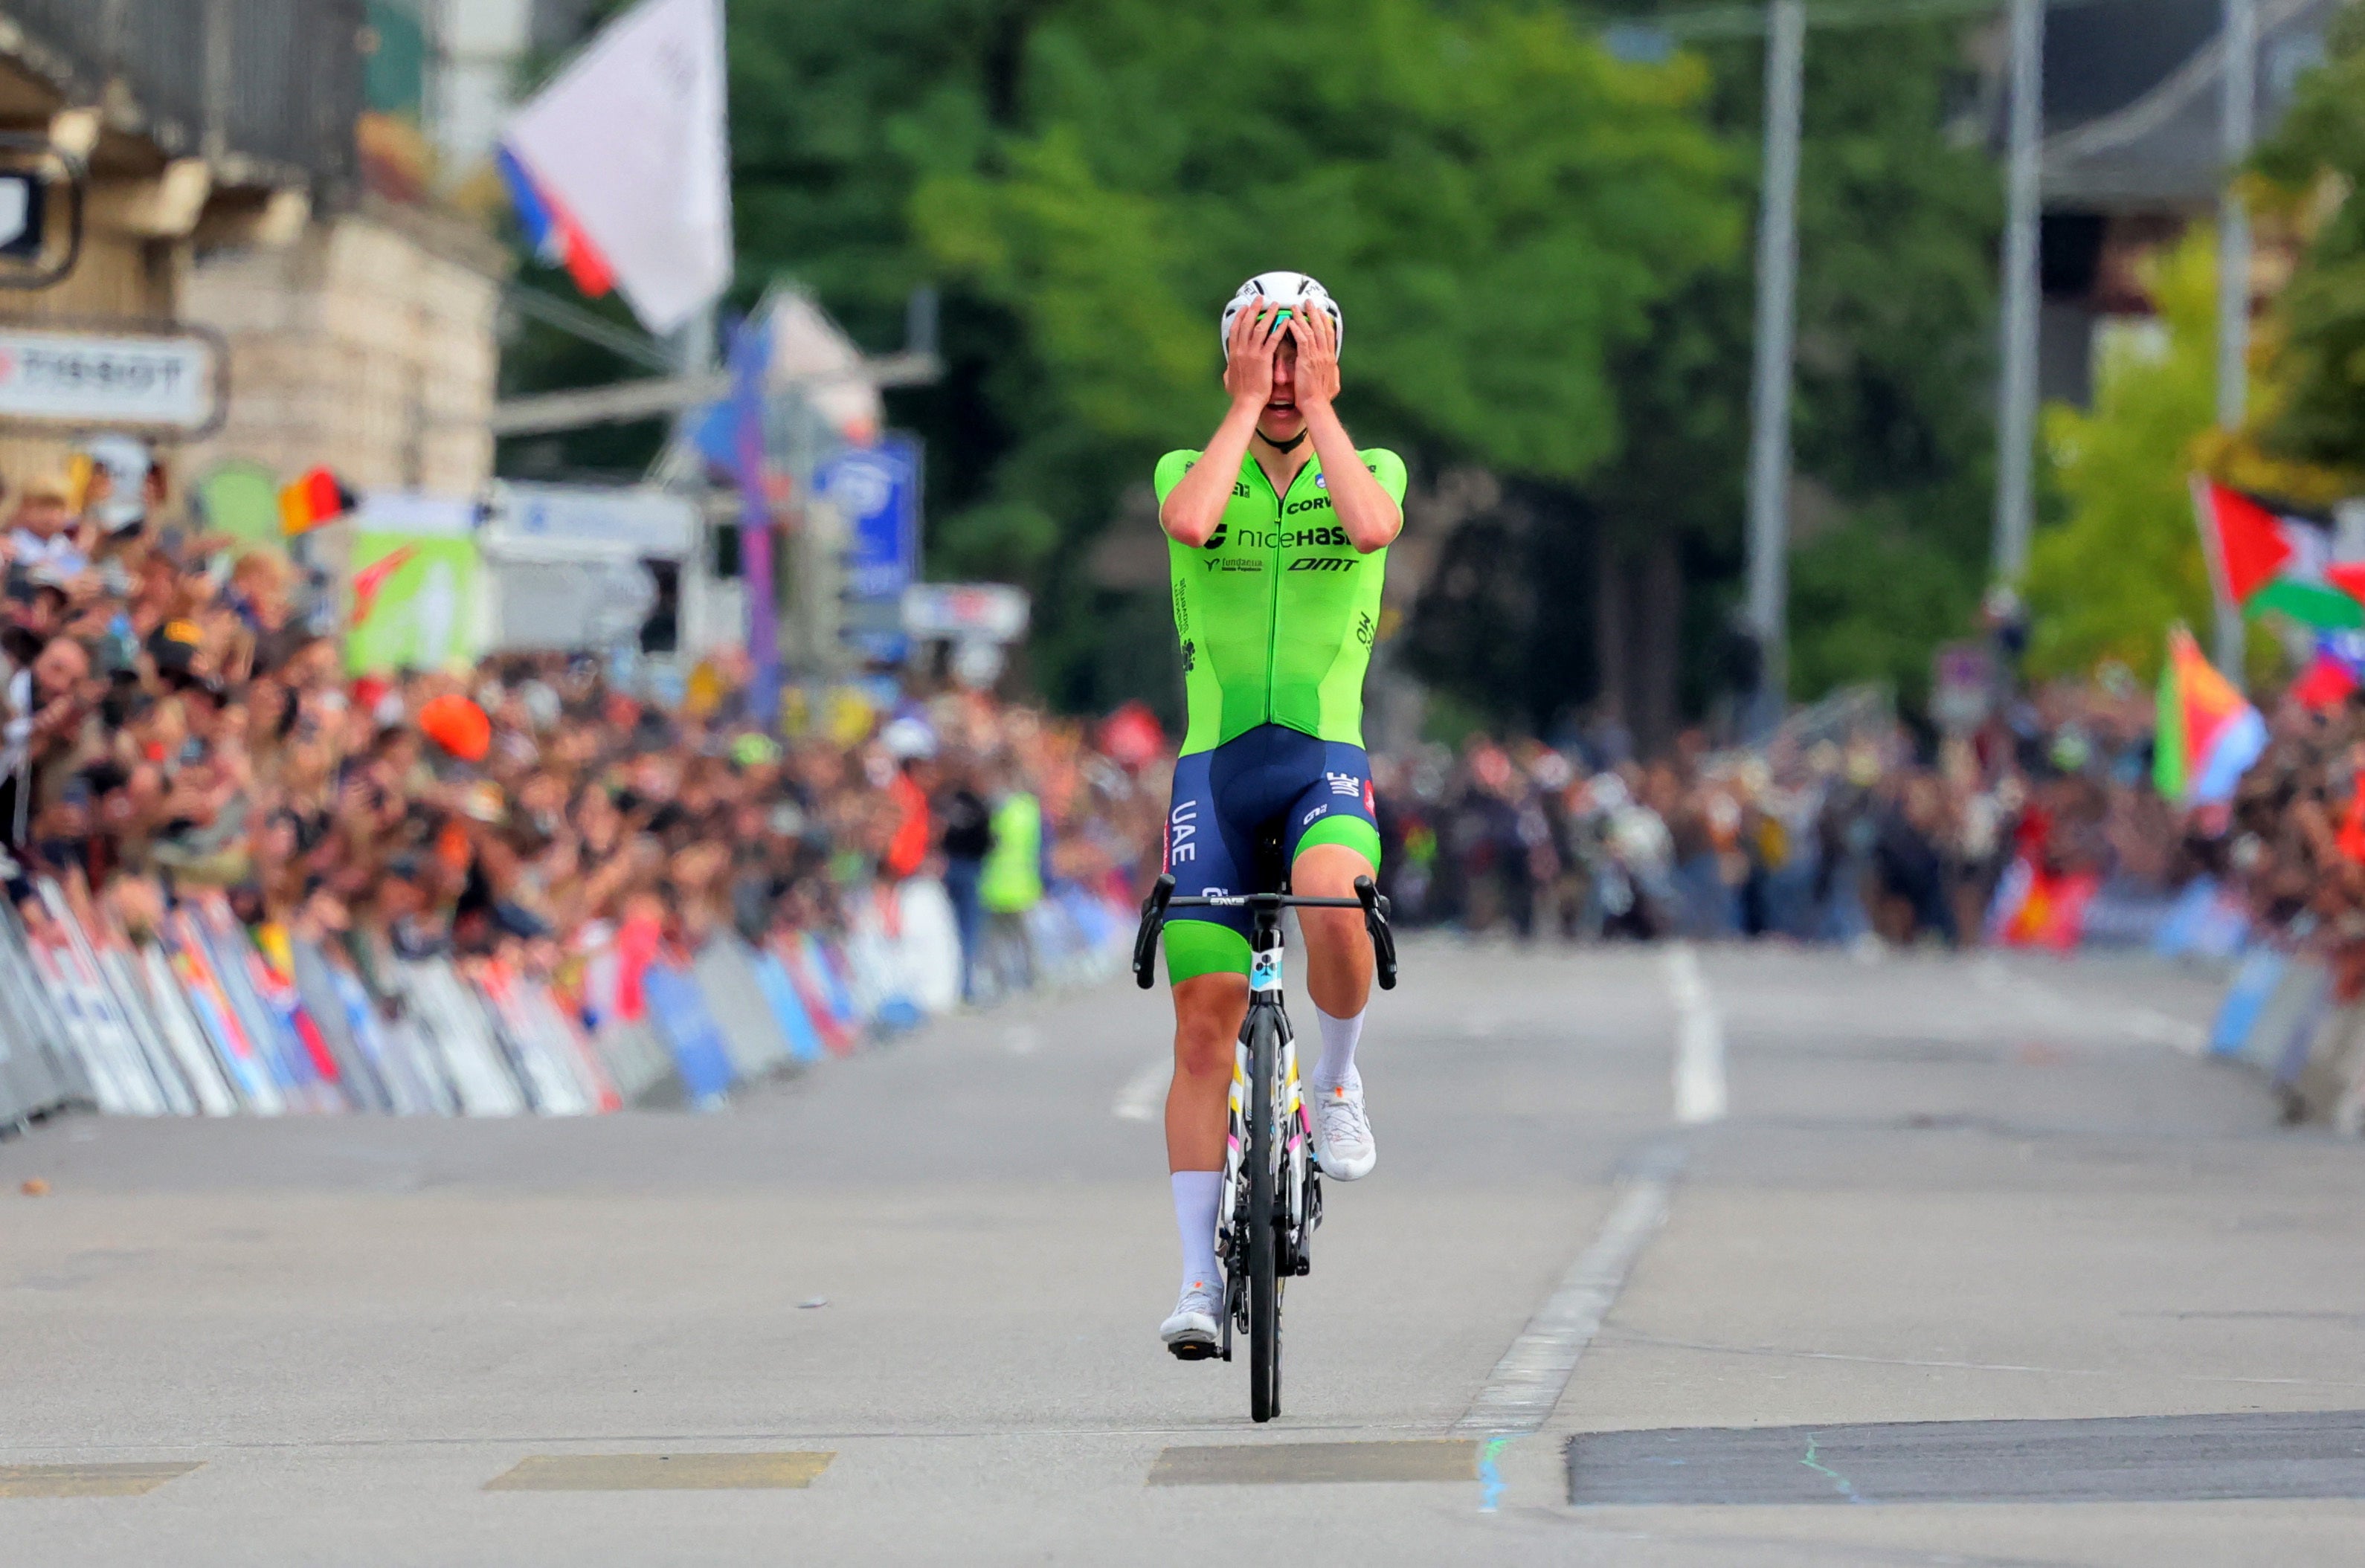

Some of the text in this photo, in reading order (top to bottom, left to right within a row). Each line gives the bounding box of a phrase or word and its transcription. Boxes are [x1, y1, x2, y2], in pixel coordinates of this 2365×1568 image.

[1287, 558, 1360, 572] DMT
[1326, 772, 1360, 798] UAE
[1172, 800, 1197, 866] UAE
